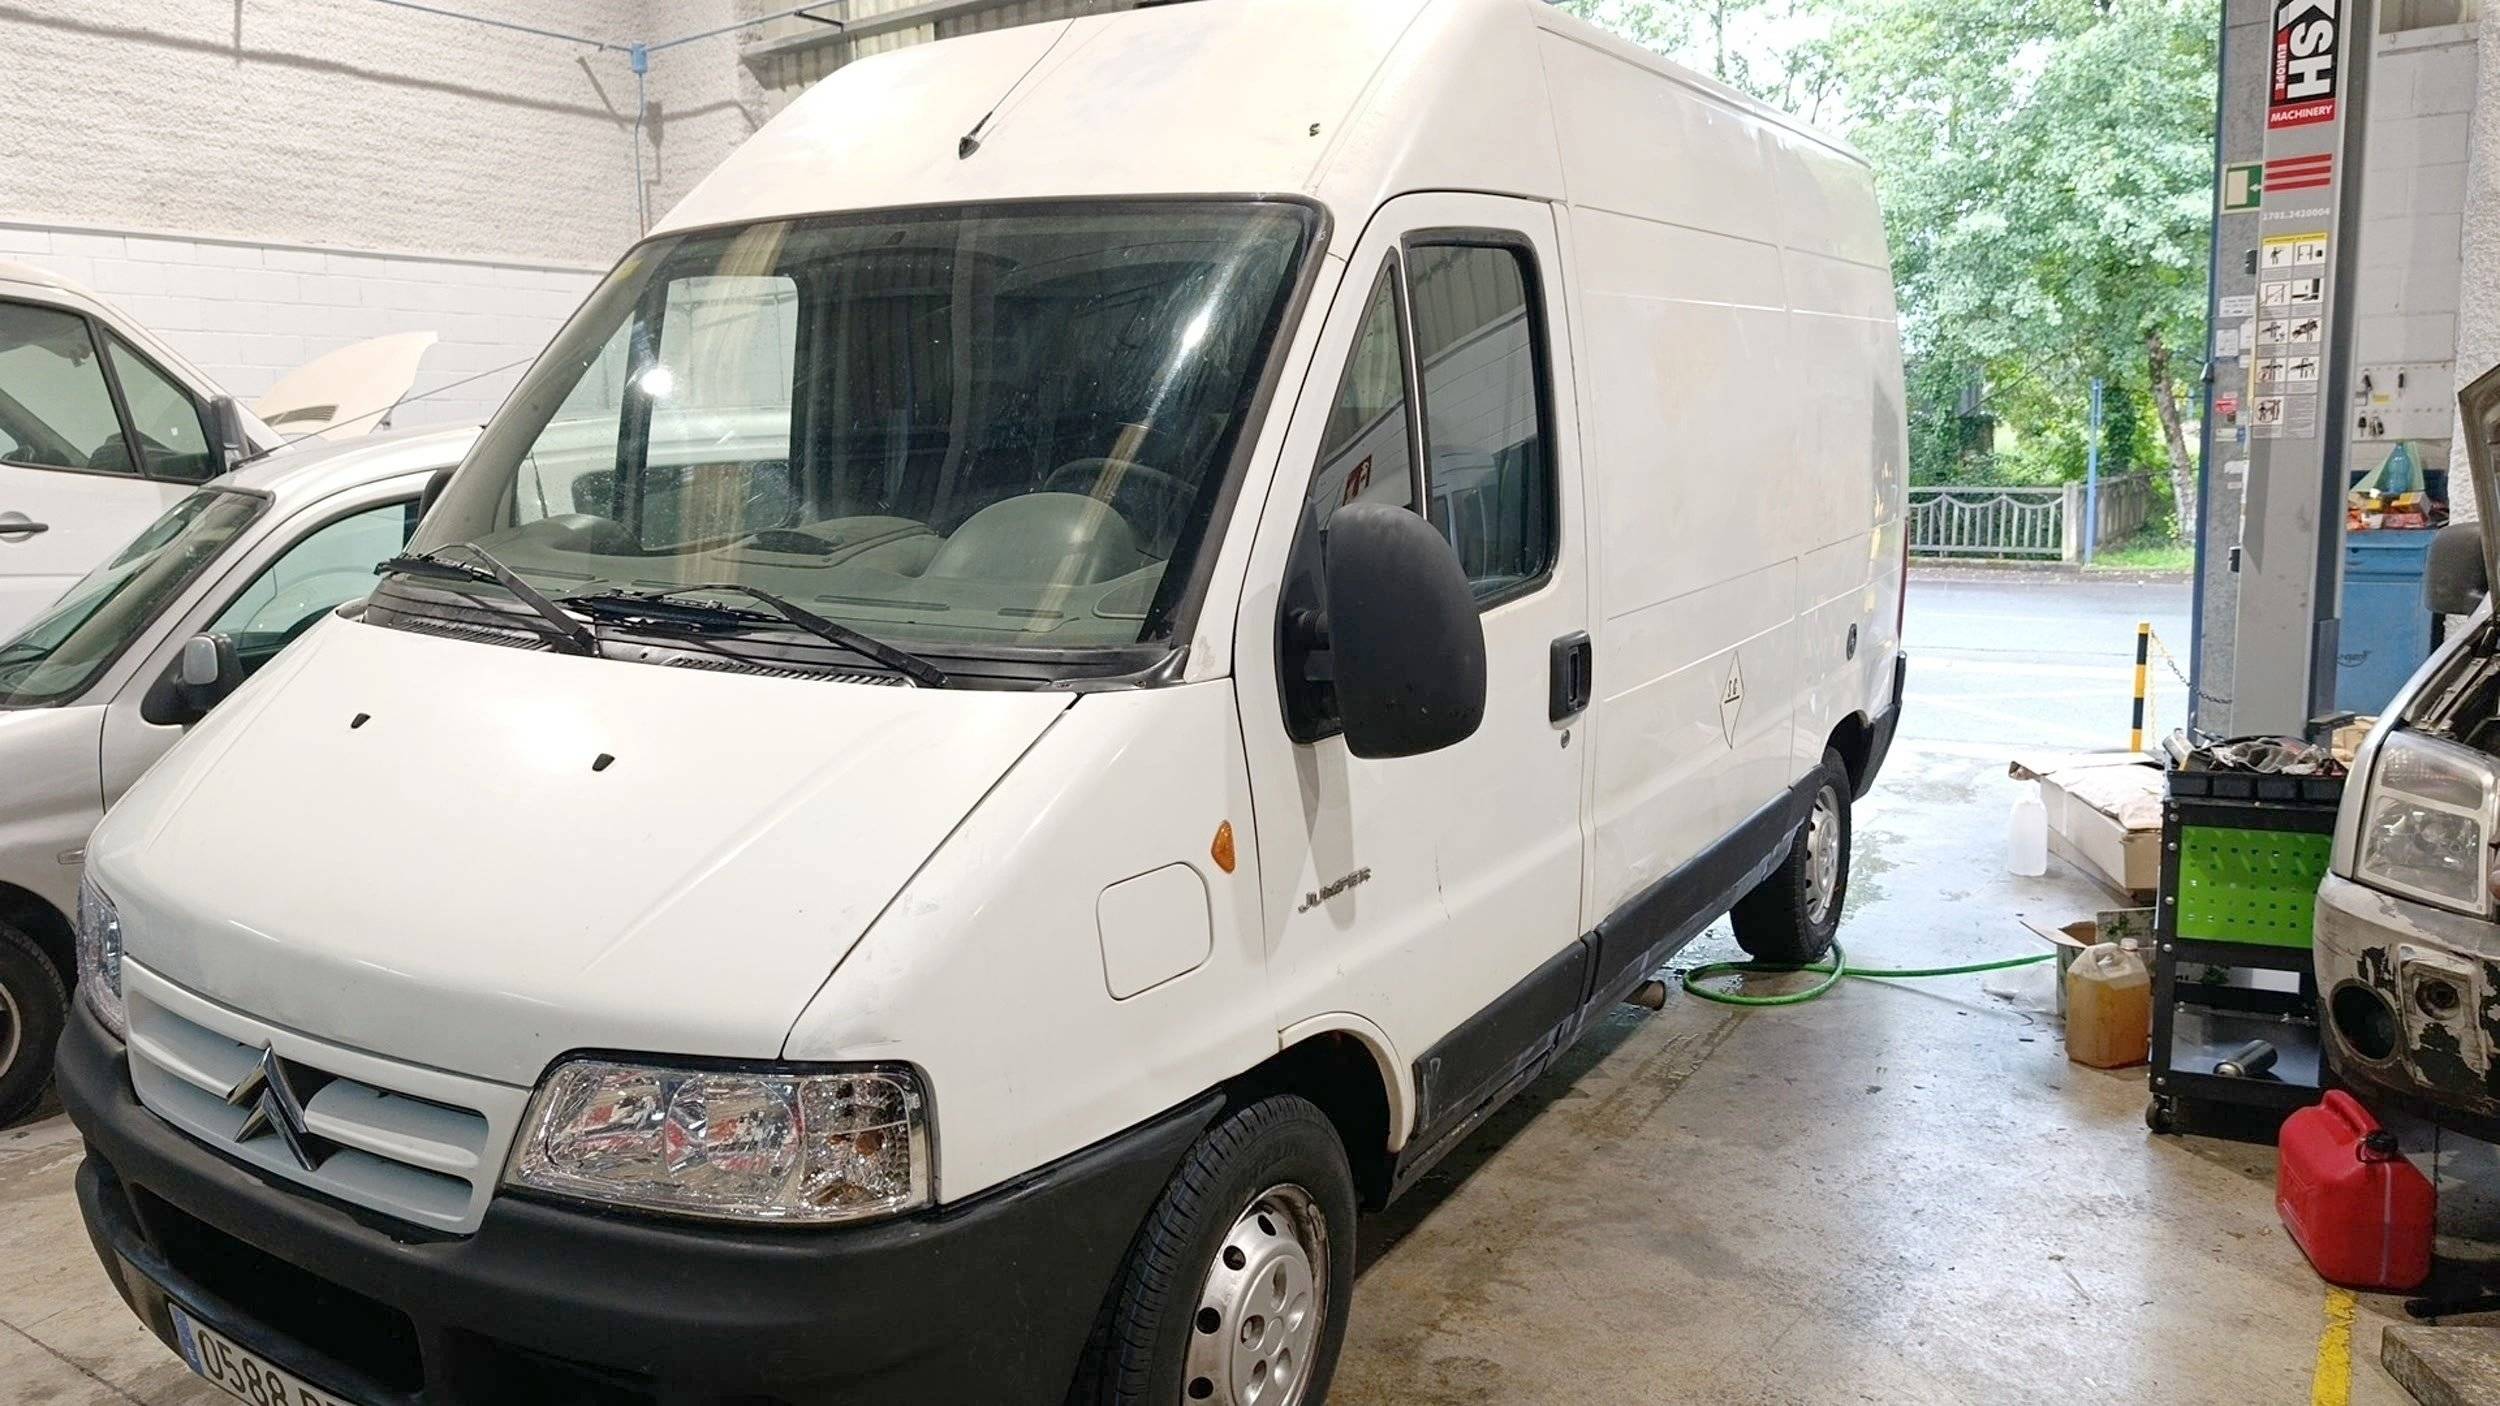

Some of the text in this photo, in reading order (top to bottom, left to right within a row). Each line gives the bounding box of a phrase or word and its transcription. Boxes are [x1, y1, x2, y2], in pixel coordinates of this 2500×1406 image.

[2275, 44, 2287, 90] EUROPE
[2271, 105, 2333, 122] MACHINERY
[1298, 866, 1371, 913] JUMPER
[198, 1328, 290, 1406] 0588
